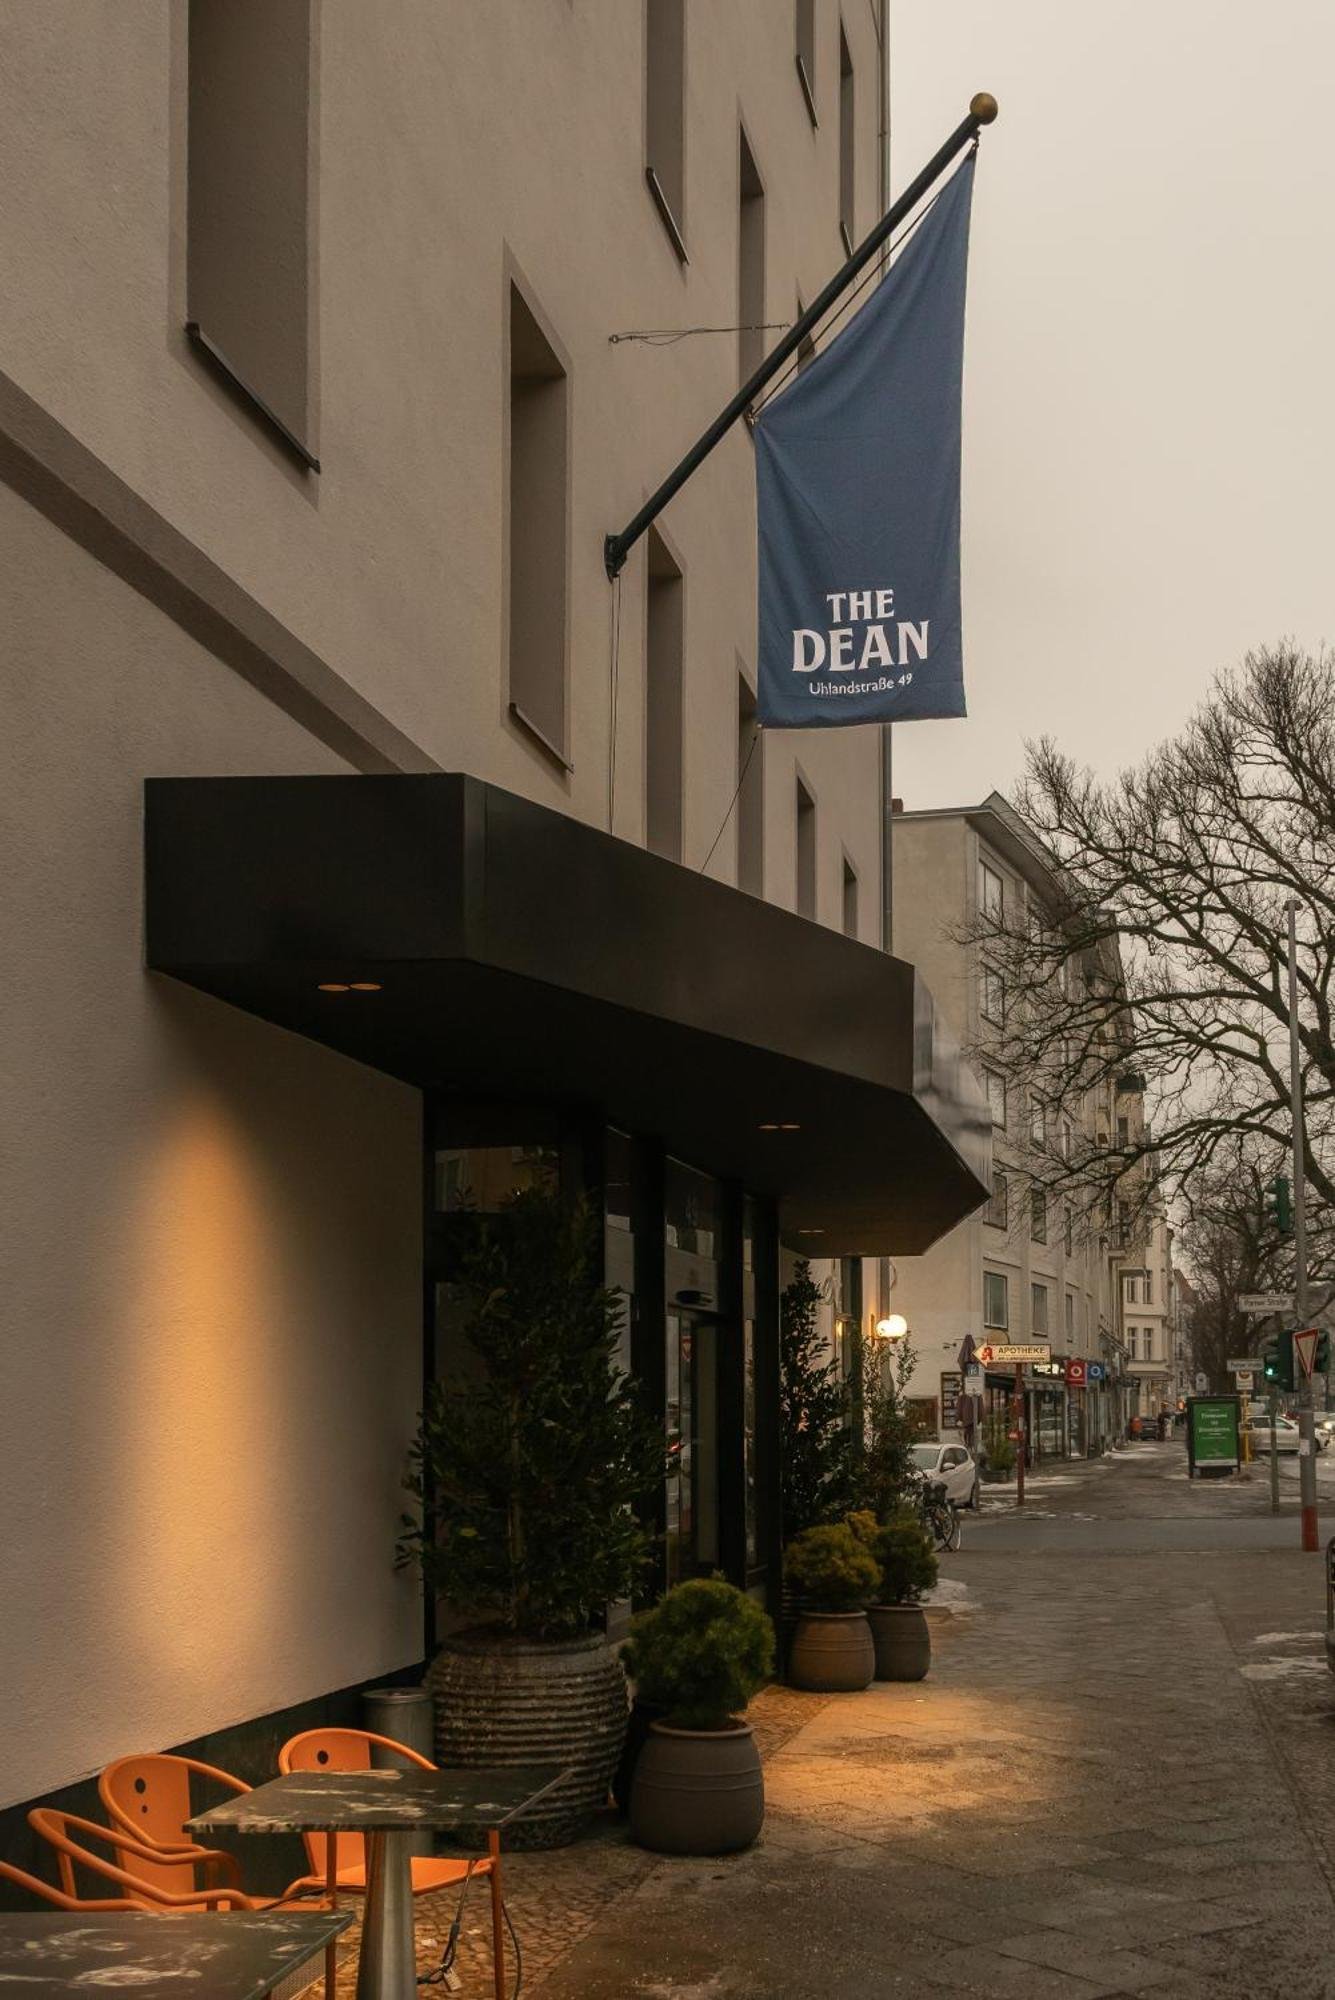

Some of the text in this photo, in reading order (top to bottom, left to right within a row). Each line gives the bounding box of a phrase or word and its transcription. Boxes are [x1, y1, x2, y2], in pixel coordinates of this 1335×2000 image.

[826, 588, 895, 623] THE
[792, 620, 929, 672] DEAN
[808, 673, 912, 696] Uhlandstraße 49
